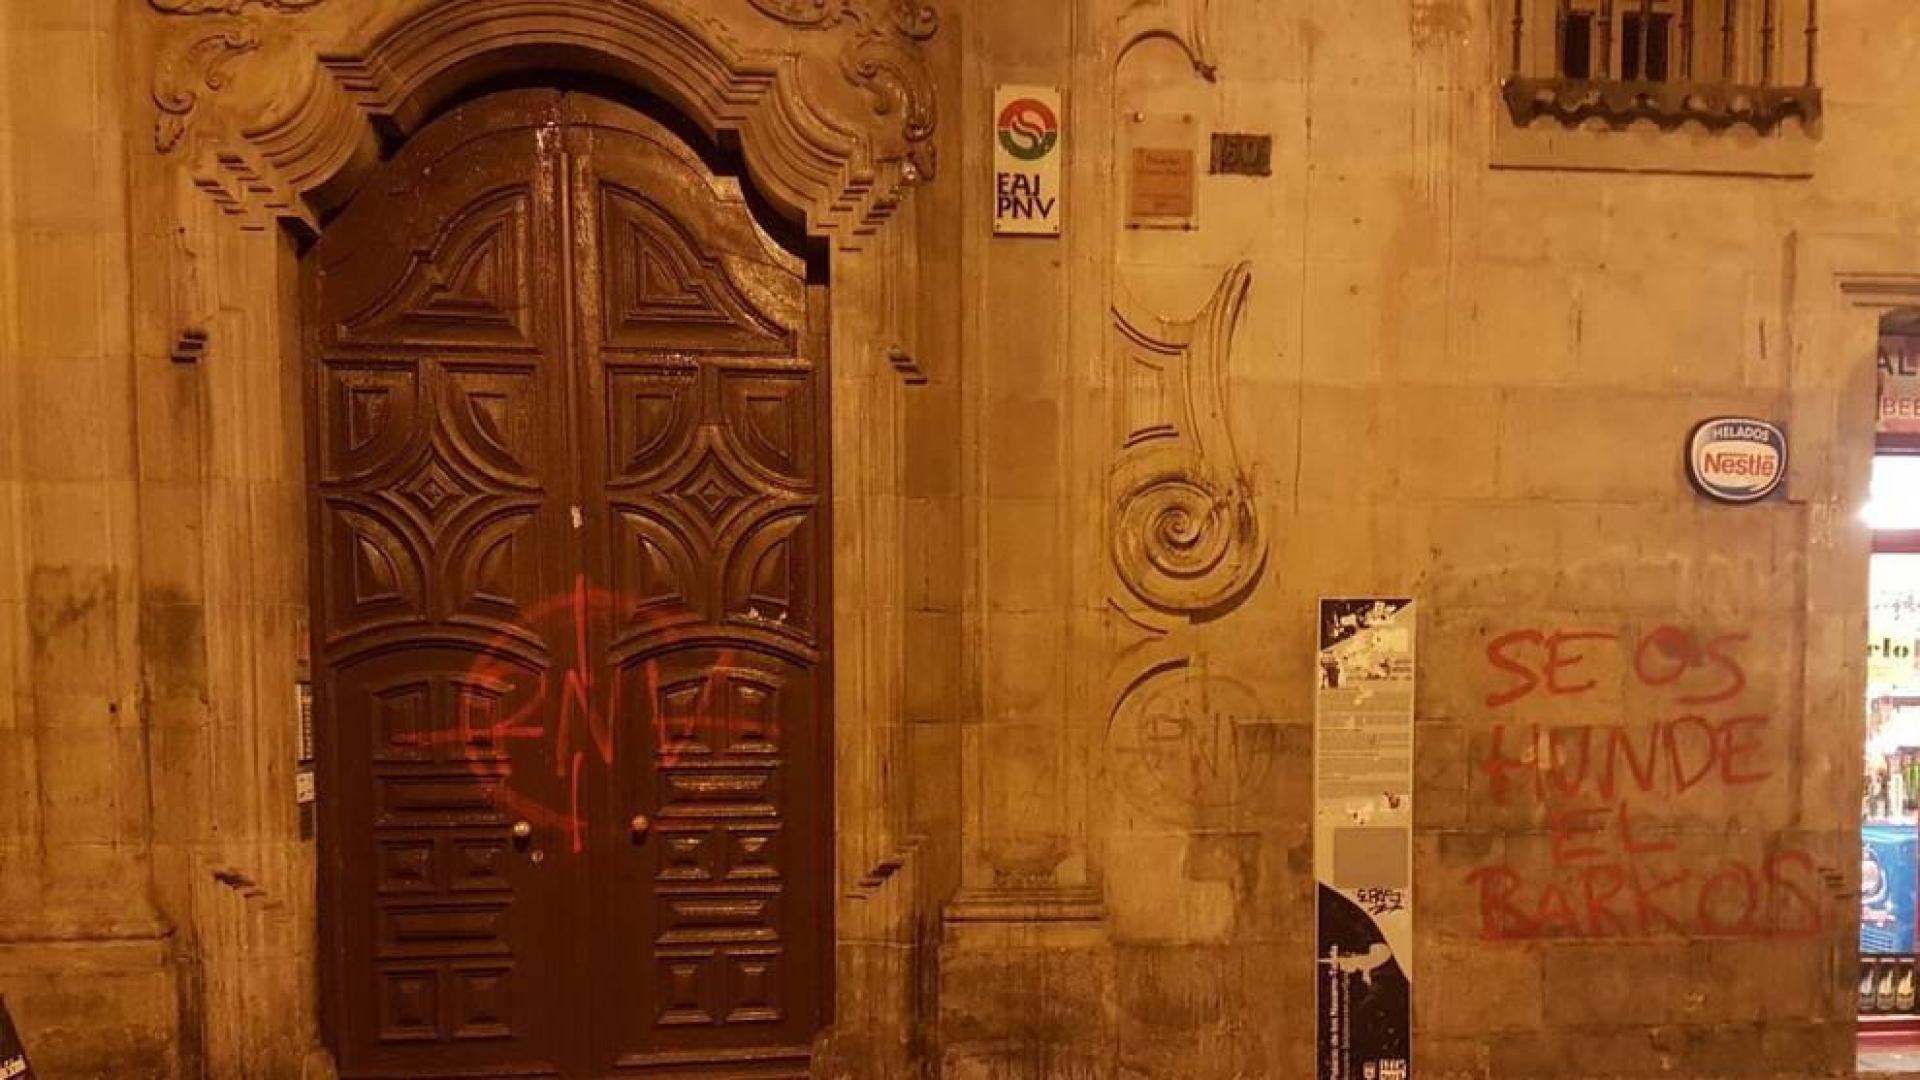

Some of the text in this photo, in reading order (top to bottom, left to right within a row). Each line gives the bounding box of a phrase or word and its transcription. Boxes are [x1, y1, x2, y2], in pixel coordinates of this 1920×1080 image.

[997, 197, 1056, 219] PNV
[1712, 425, 1771, 441] HELADOS
[1485, 624, 1750, 708] SE OS
[466, 645, 738, 778] PNV
[1482, 714, 1774, 806] HUNDE
[1550, 802, 1676, 865] EL
[1464, 849, 1825, 942] BARKOS
